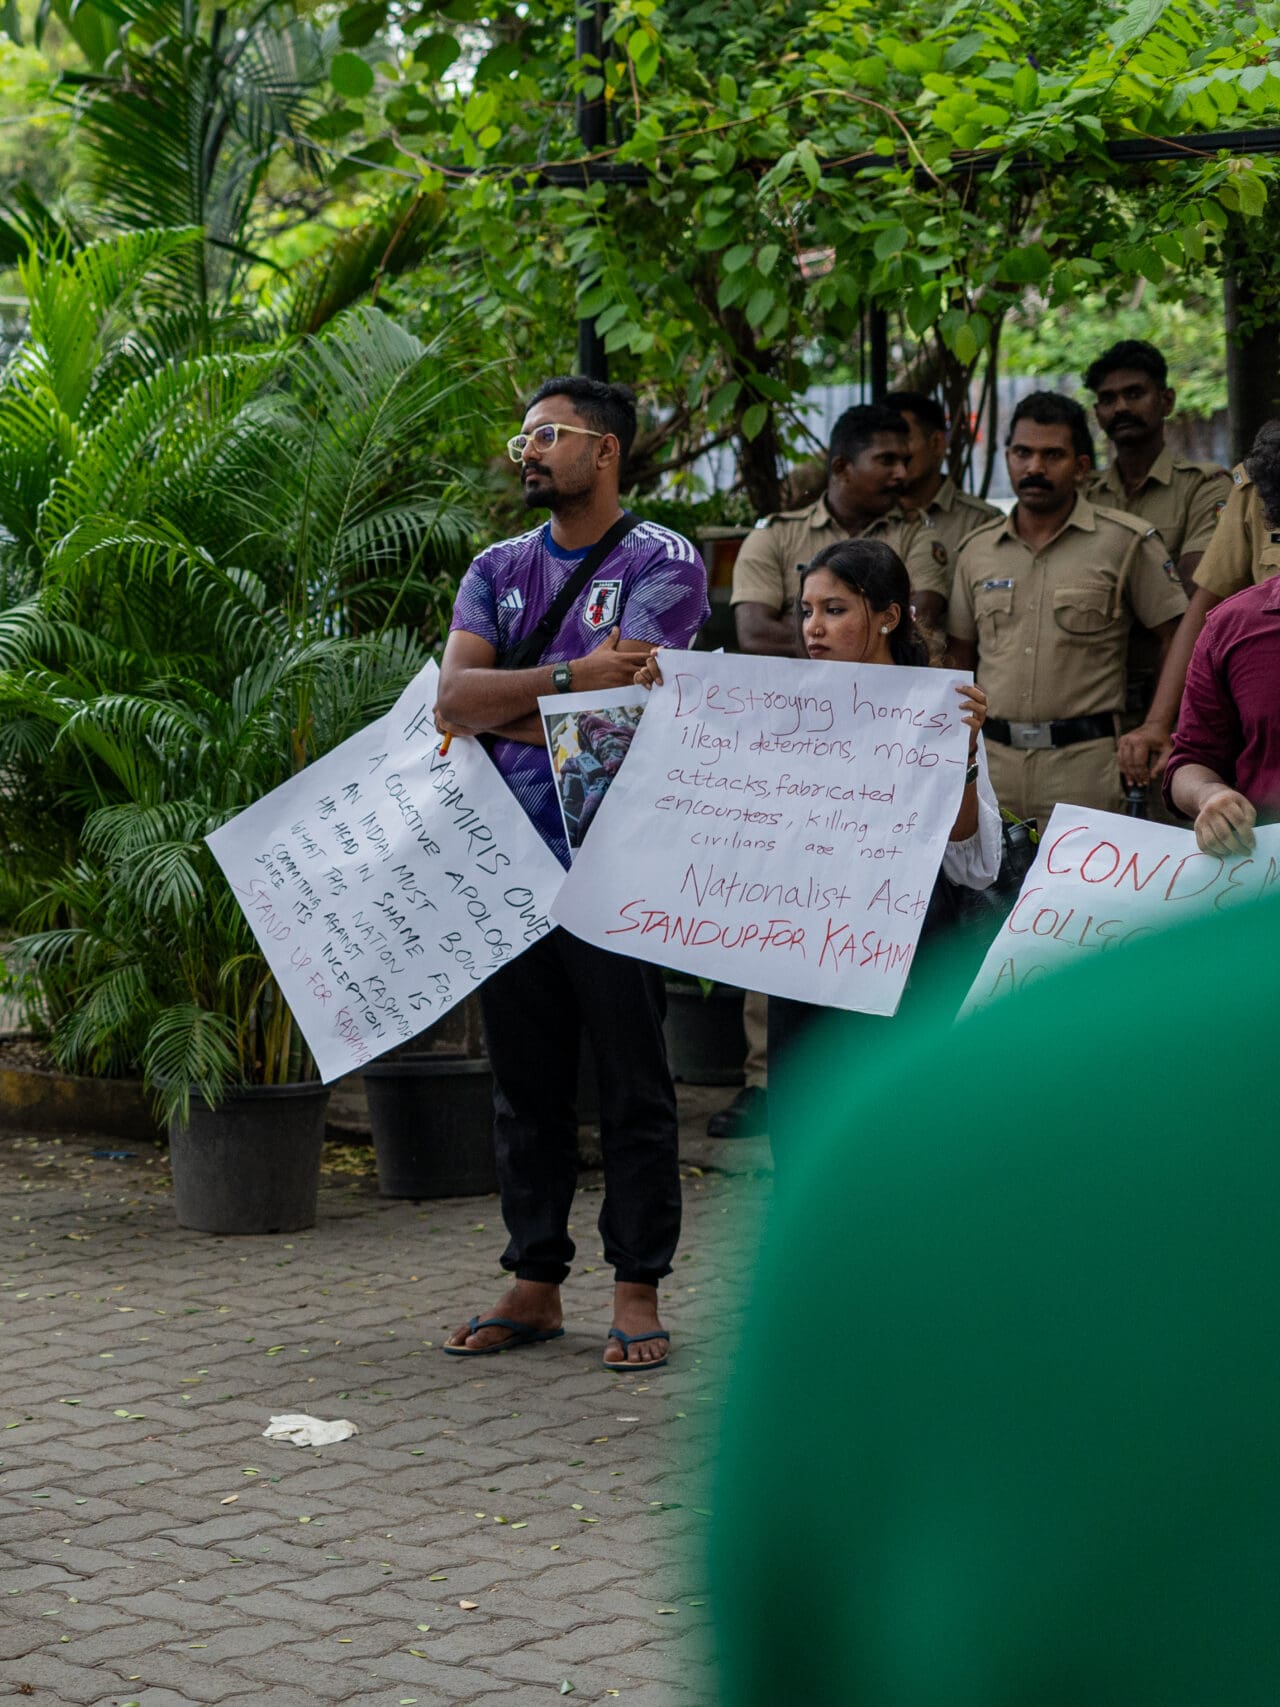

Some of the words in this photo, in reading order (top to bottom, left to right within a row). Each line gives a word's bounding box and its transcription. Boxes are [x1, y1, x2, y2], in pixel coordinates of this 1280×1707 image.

[675, 673, 834, 736] Destroying
[853, 682, 953, 736] homes,
[681, 721, 739, 766] illegal
[749, 730, 856, 764] detentions,
[367, 753, 388, 774] A
[385, 773, 441, 857] COLLECTIVE
[403, 703, 434, 741] IF
[421, 742, 511, 875] KASHMIRIS
[503, 887, 551, 942] OWE
[775, 774, 896, 804] fabricated
[892, 811, 919, 834] of
[317, 796, 337, 820] HIS
[332, 822, 360, 855] HEAD
[354, 863, 375, 883] IN
[371, 892, 425, 959] SHAME
[427, 972, 455, 1010] FOR
[342, 782, 363, 805] AN
[357, 811, 394, 862] INDIAN
[391, 864, 439, 912] MUST
[438, 931, 482, 981] BOW
[680, 863, 852, 912] Nationalist
[804, 843, 835, 856] are
[860, 845, 904, 860] not
[232, 878, 292, 942] STAND
[290, 946, 312, 972] UP
[305, 972, 333, 1008] FOR
[334, 1005, 373, 1065] KASHMIR
[254, 853, 285, 890] SINCE
[291, 900, 313, 925] ITS
[320, 942, 387, 1039] INCEPTION
[290, 819, 327, 859] WHAT
[322, 866, 349, 896] THIS
[351, 911, 405, 974] NATION
[407, 991, 433, 1012] IS
[323, 912, 365, 961] AGAINST
[363, 975, 414, 1038] KASHMIR
